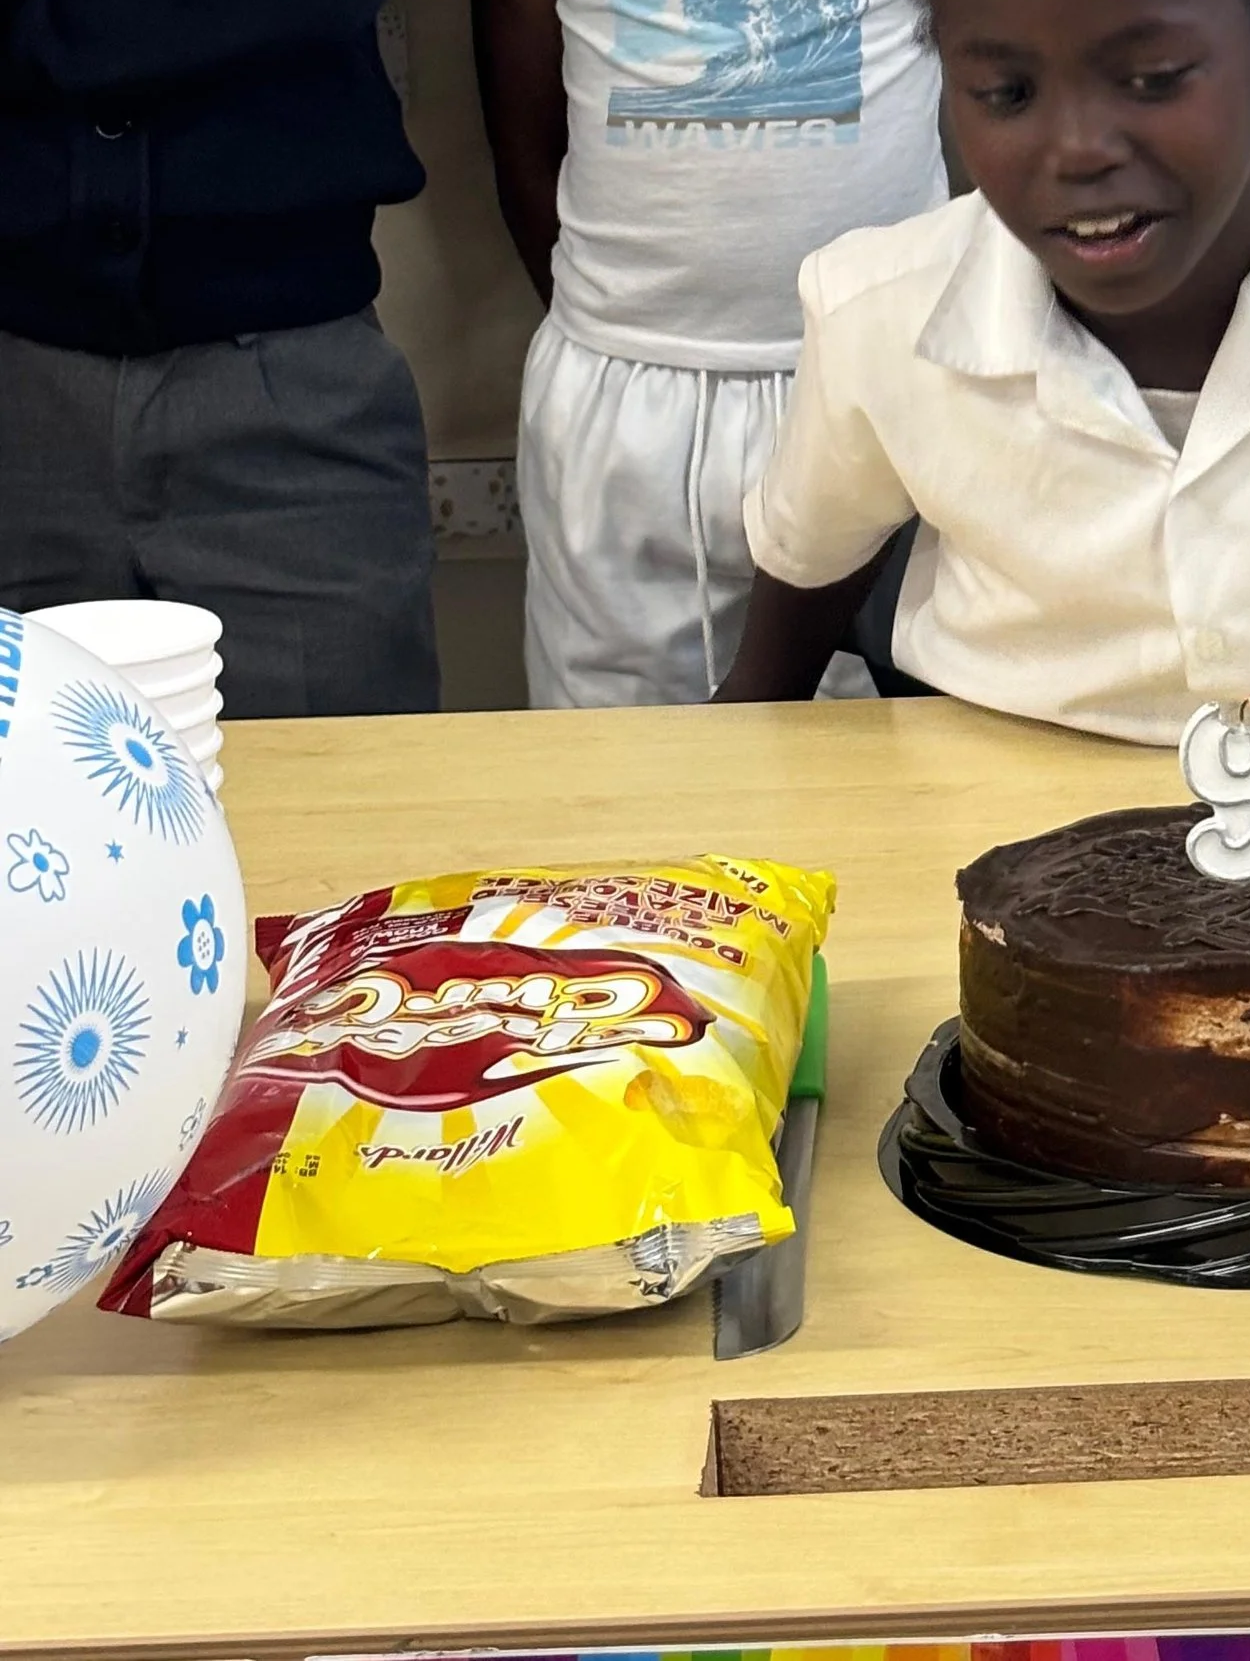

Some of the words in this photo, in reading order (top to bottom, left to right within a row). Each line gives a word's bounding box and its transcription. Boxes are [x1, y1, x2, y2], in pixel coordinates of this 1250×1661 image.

[624, 118, 837, 150] WAVES
[650, 878, 790, 939] MAIZE
[568, 911, 746, 966] DOUBLE
[360, 1116, 523, 1176] Willards
